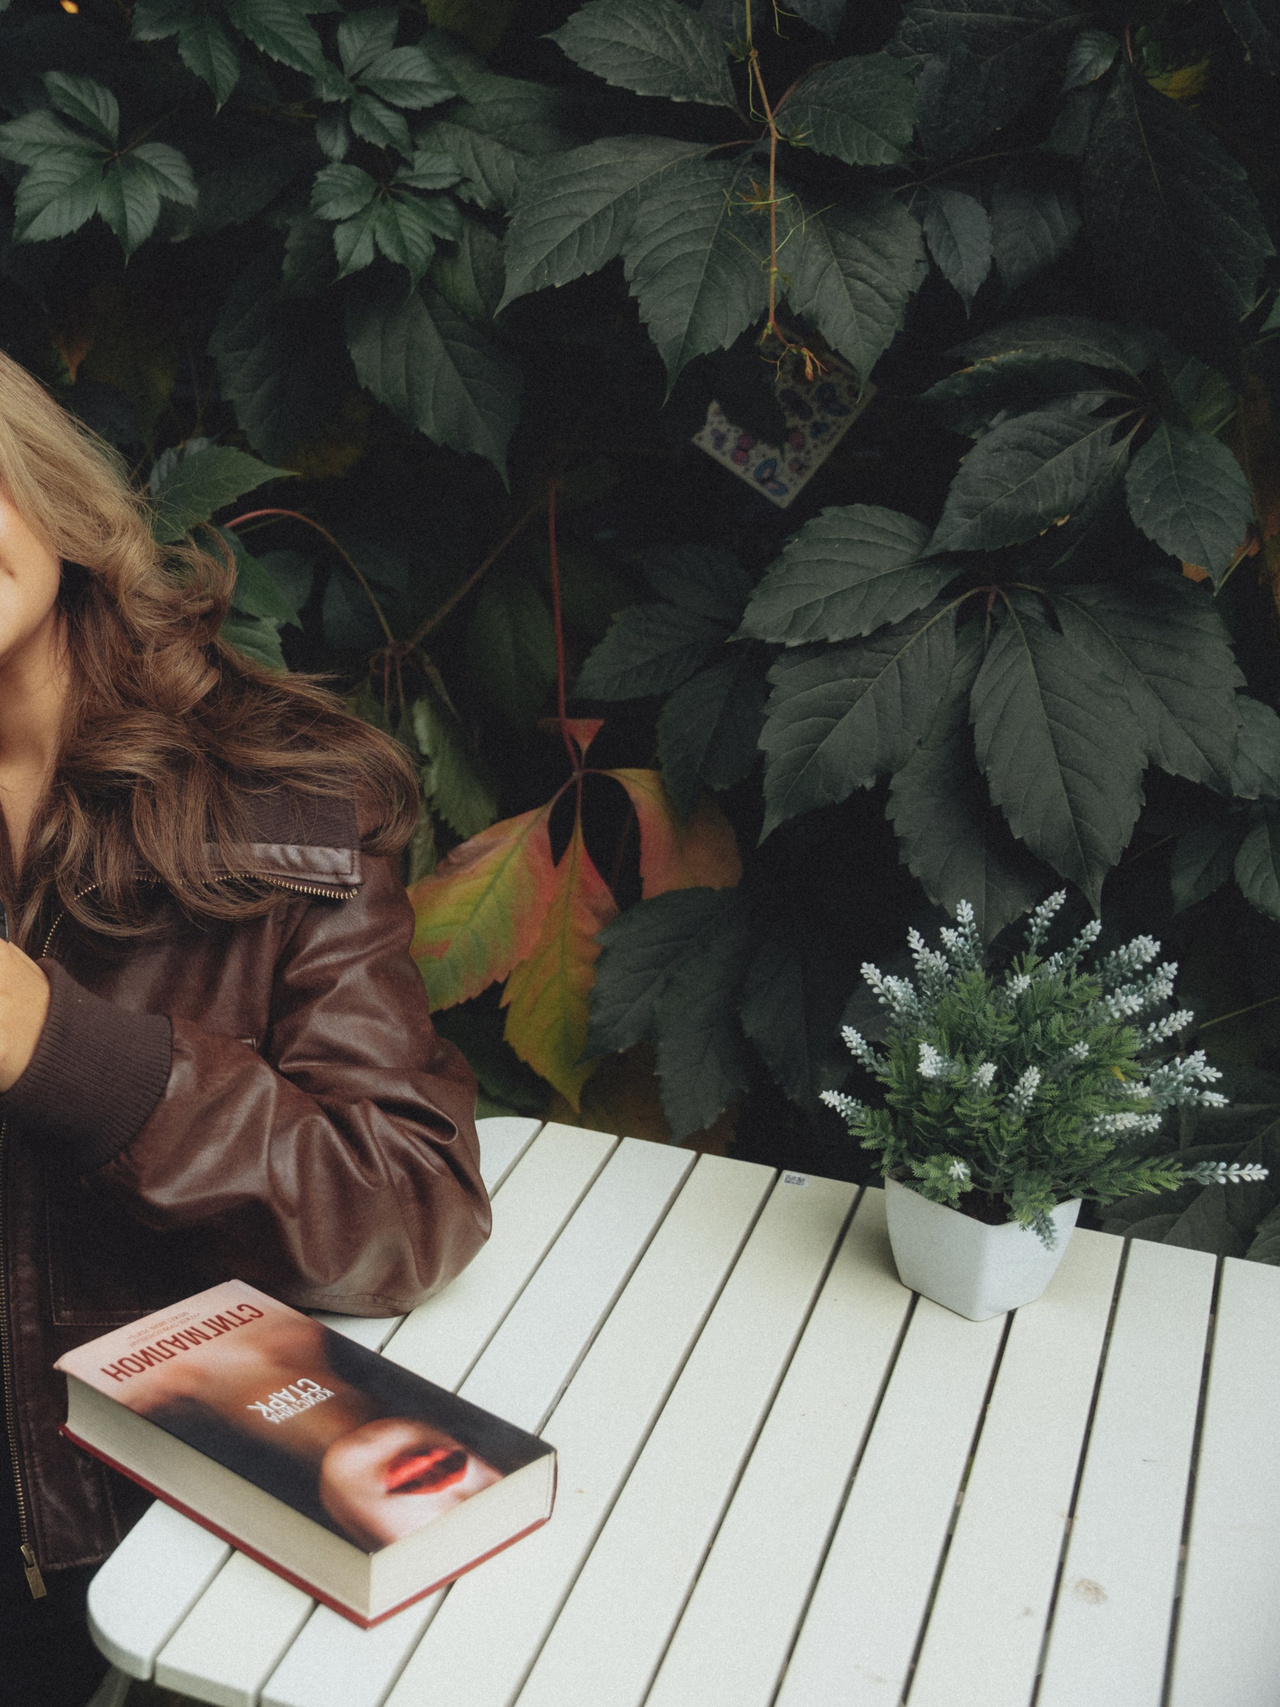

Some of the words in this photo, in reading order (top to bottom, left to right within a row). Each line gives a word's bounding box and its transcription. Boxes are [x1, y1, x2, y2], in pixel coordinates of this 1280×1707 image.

[100, 1303, 265, 1382] СТИГМАЛИОН
[246, 1378, 322, 1418] СТАРК
[265, 1387, 335, 1424] КРИСТИНА
